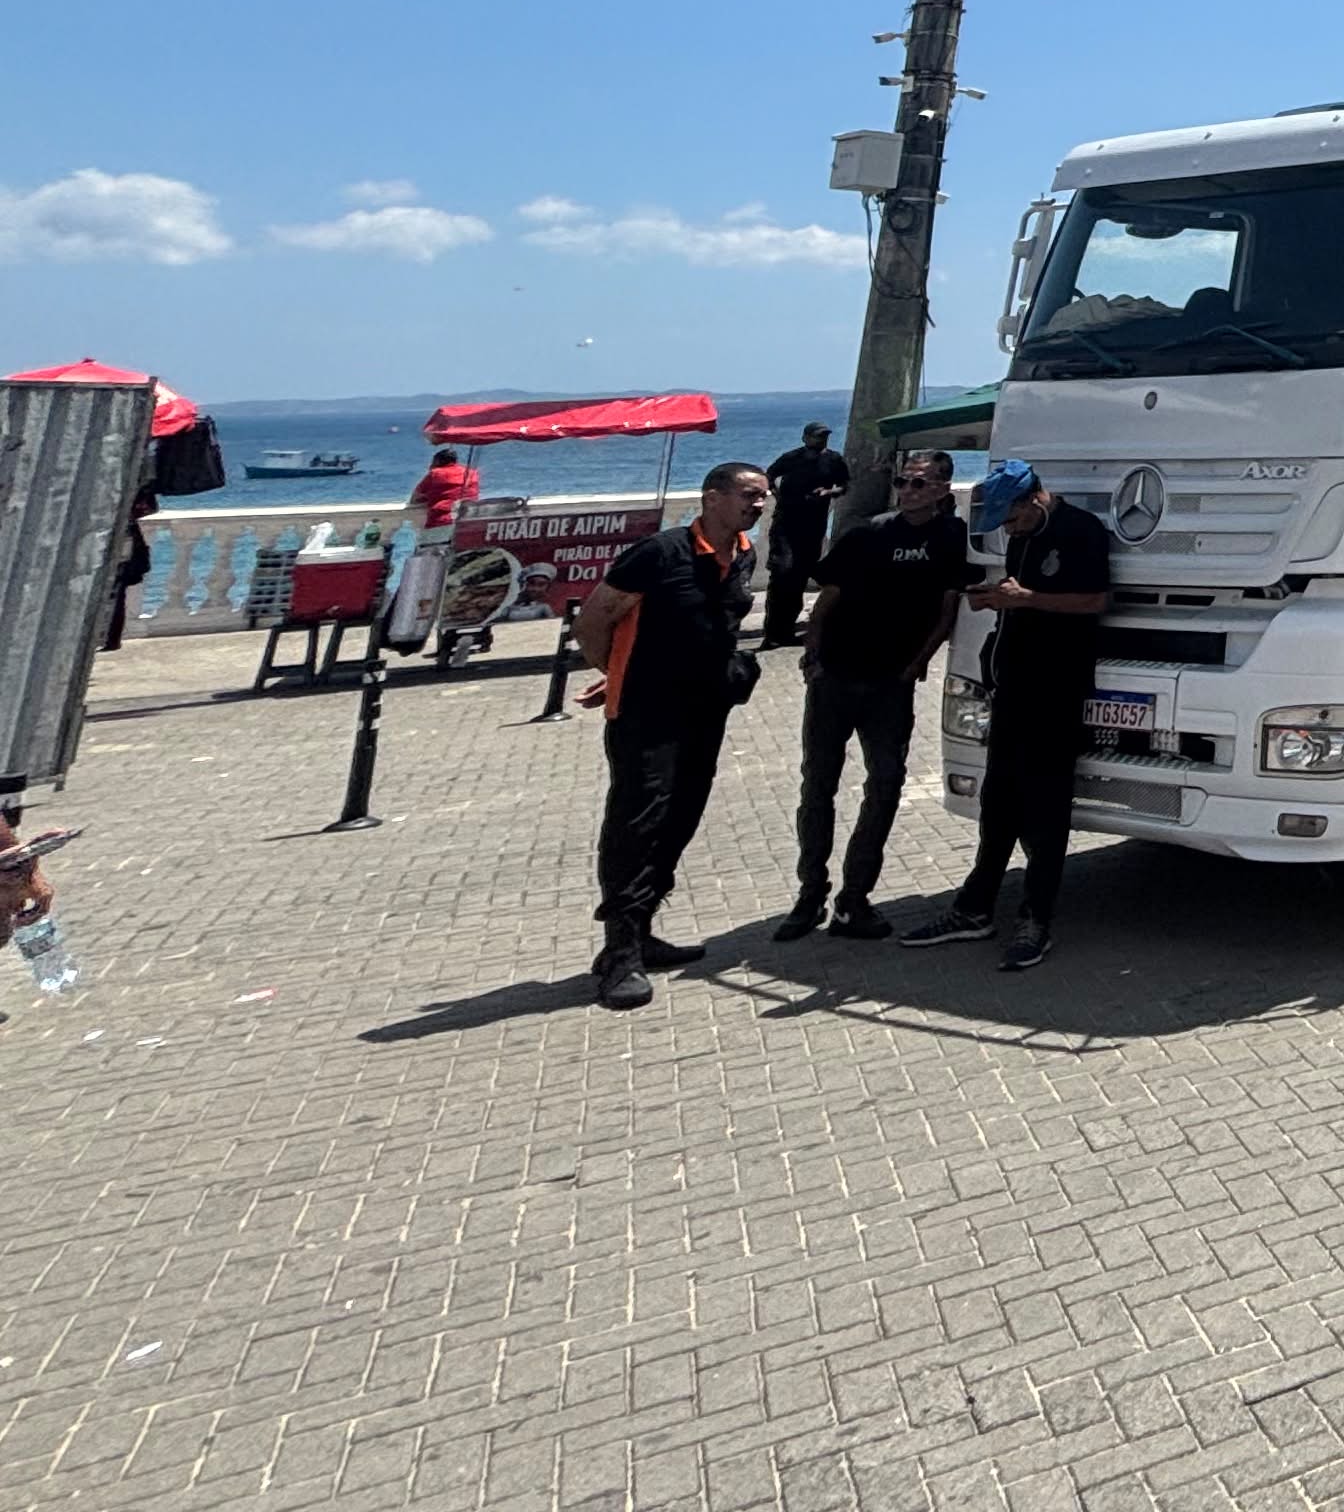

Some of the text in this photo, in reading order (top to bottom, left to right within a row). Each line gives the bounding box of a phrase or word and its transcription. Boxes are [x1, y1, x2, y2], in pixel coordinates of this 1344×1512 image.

[485, 514, 627, 541] PIRÃO DE AIPIM
[553, 544, 592, 562] PIRÃO
[595, 544, 611, 560] DE
[568, 563, 597, 581] Da
[1084, 701, 1148, 727] HTG3C57
